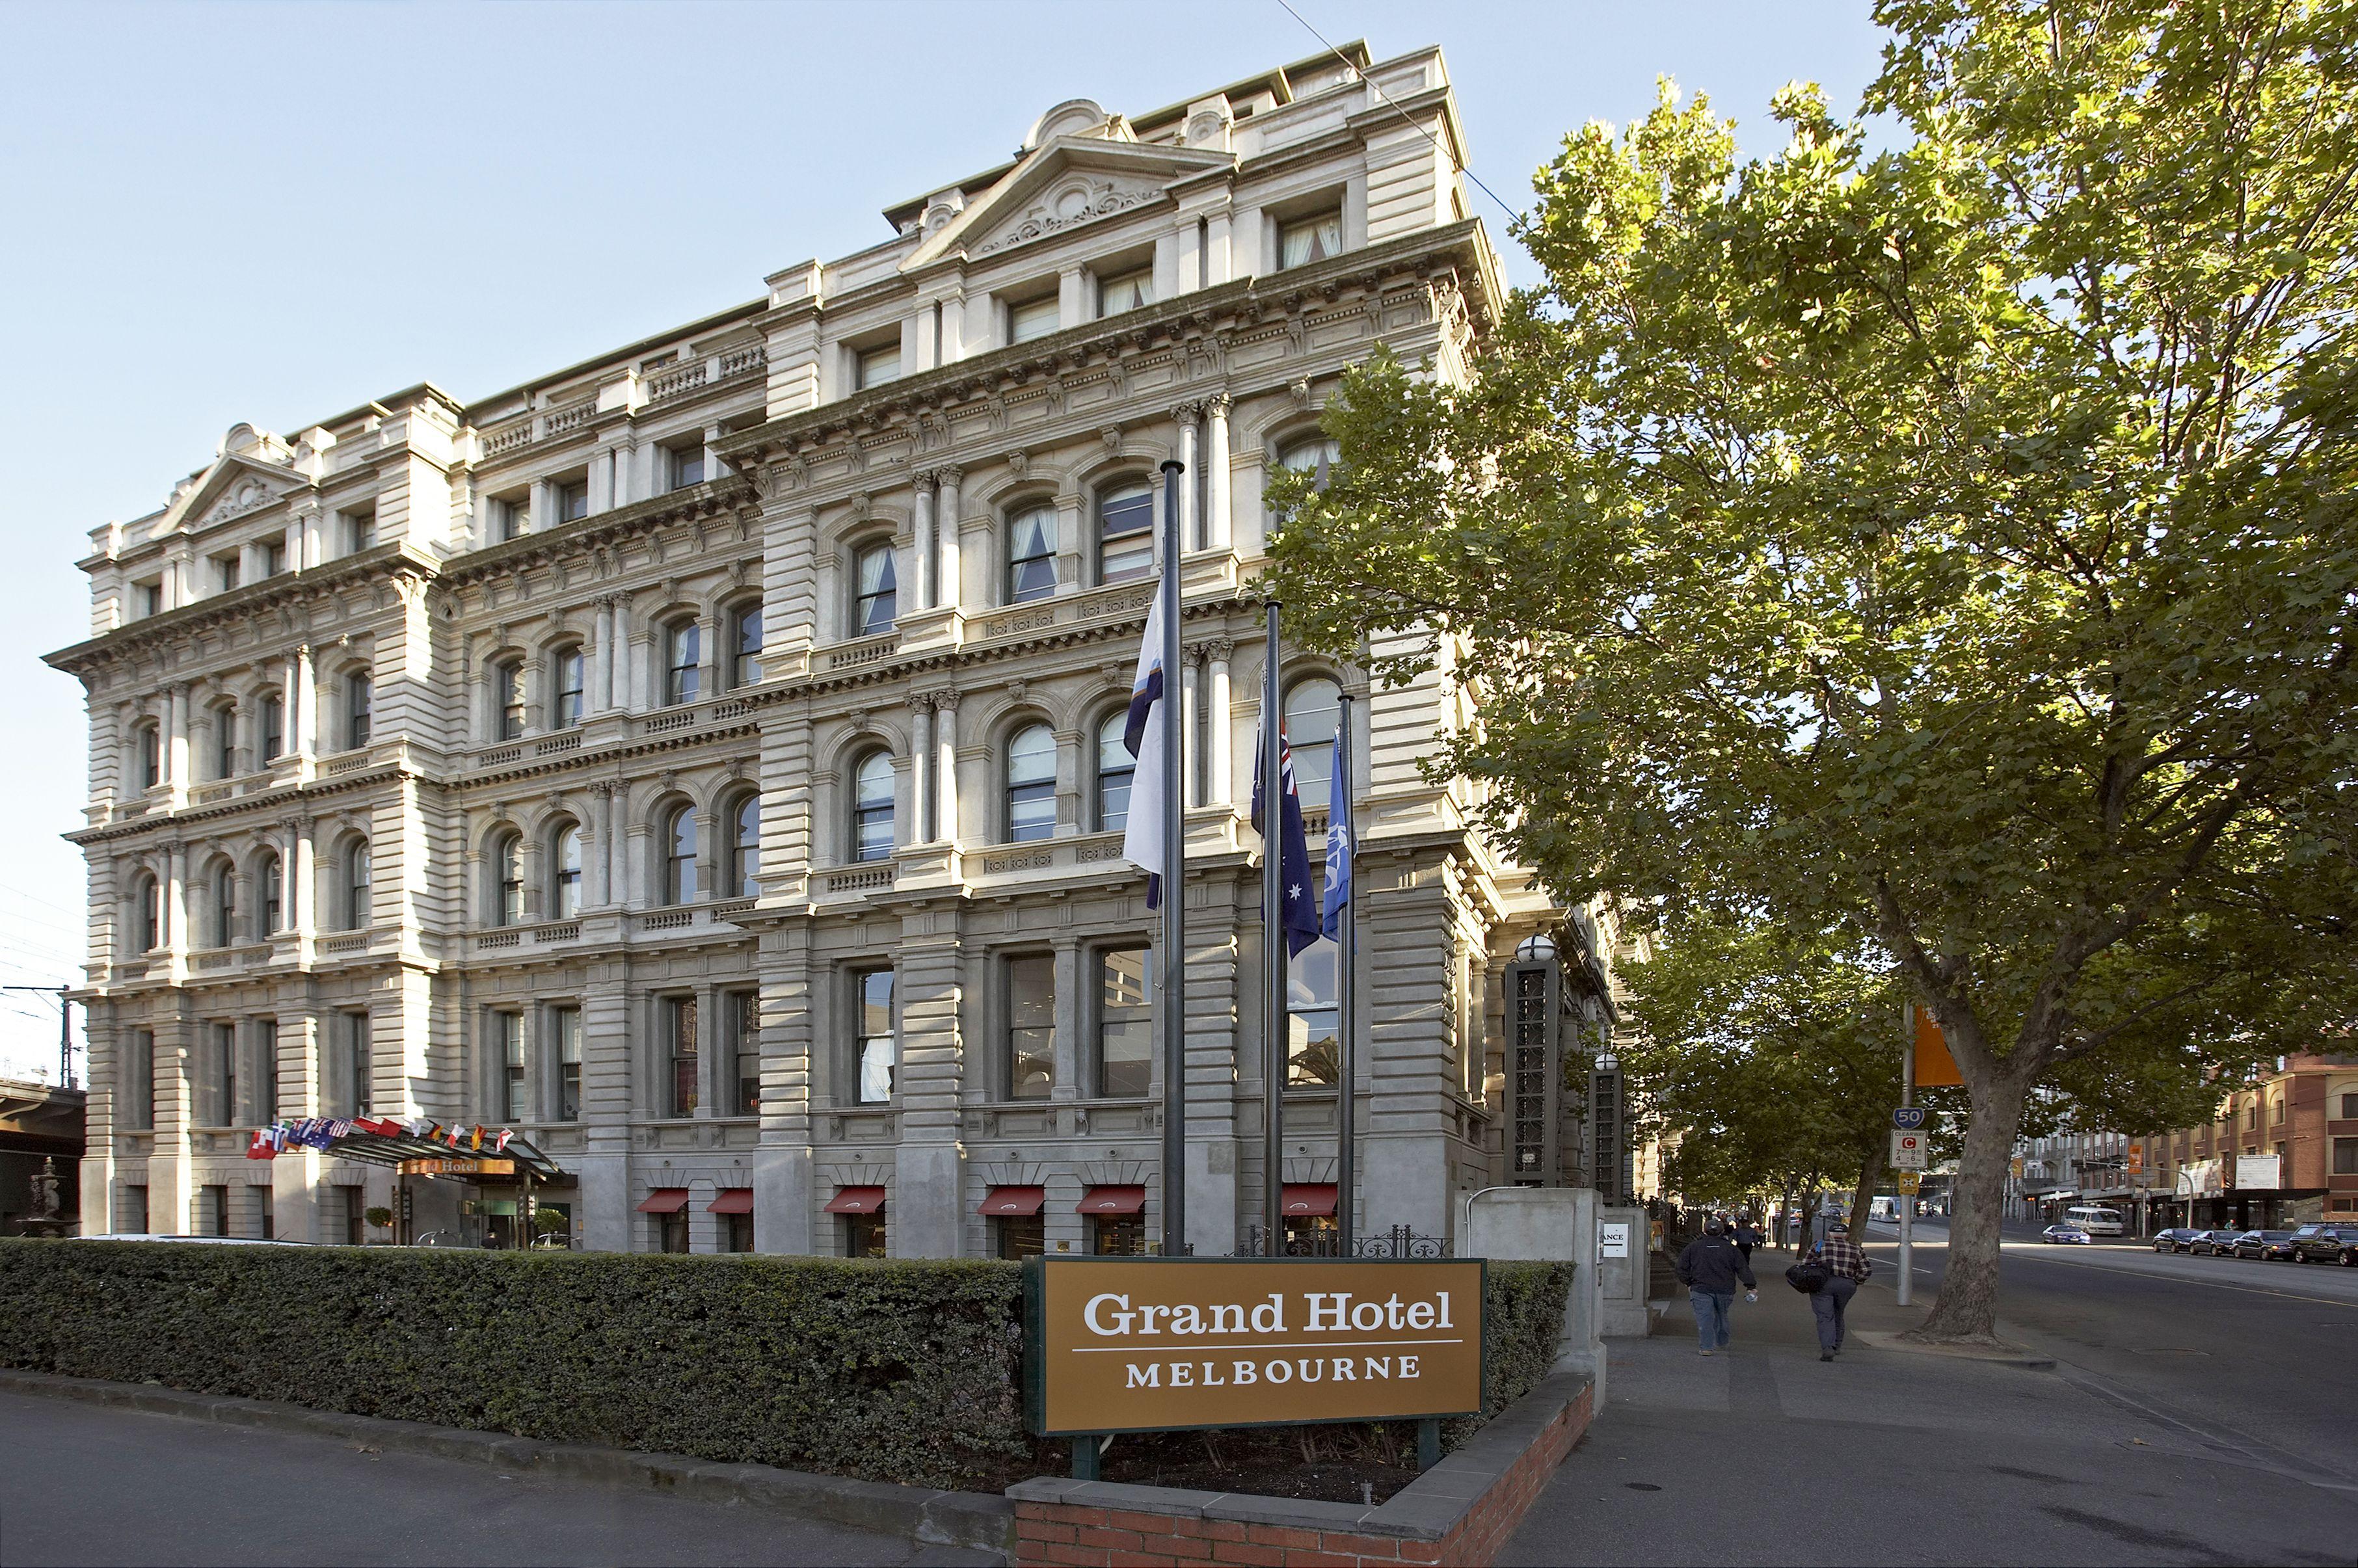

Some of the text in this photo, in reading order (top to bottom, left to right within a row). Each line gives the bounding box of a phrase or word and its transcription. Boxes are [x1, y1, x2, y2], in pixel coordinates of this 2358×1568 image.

[1898, 1111, 1920, 1122] 50
[1905, 1138, 1914, 1148] C
[442, 1161, 477, 1171] Hotel
[1084, 1292, 1454, 1336] Grand Hotel
[1125, 1355, 1420, 1389] MELBOURNE
